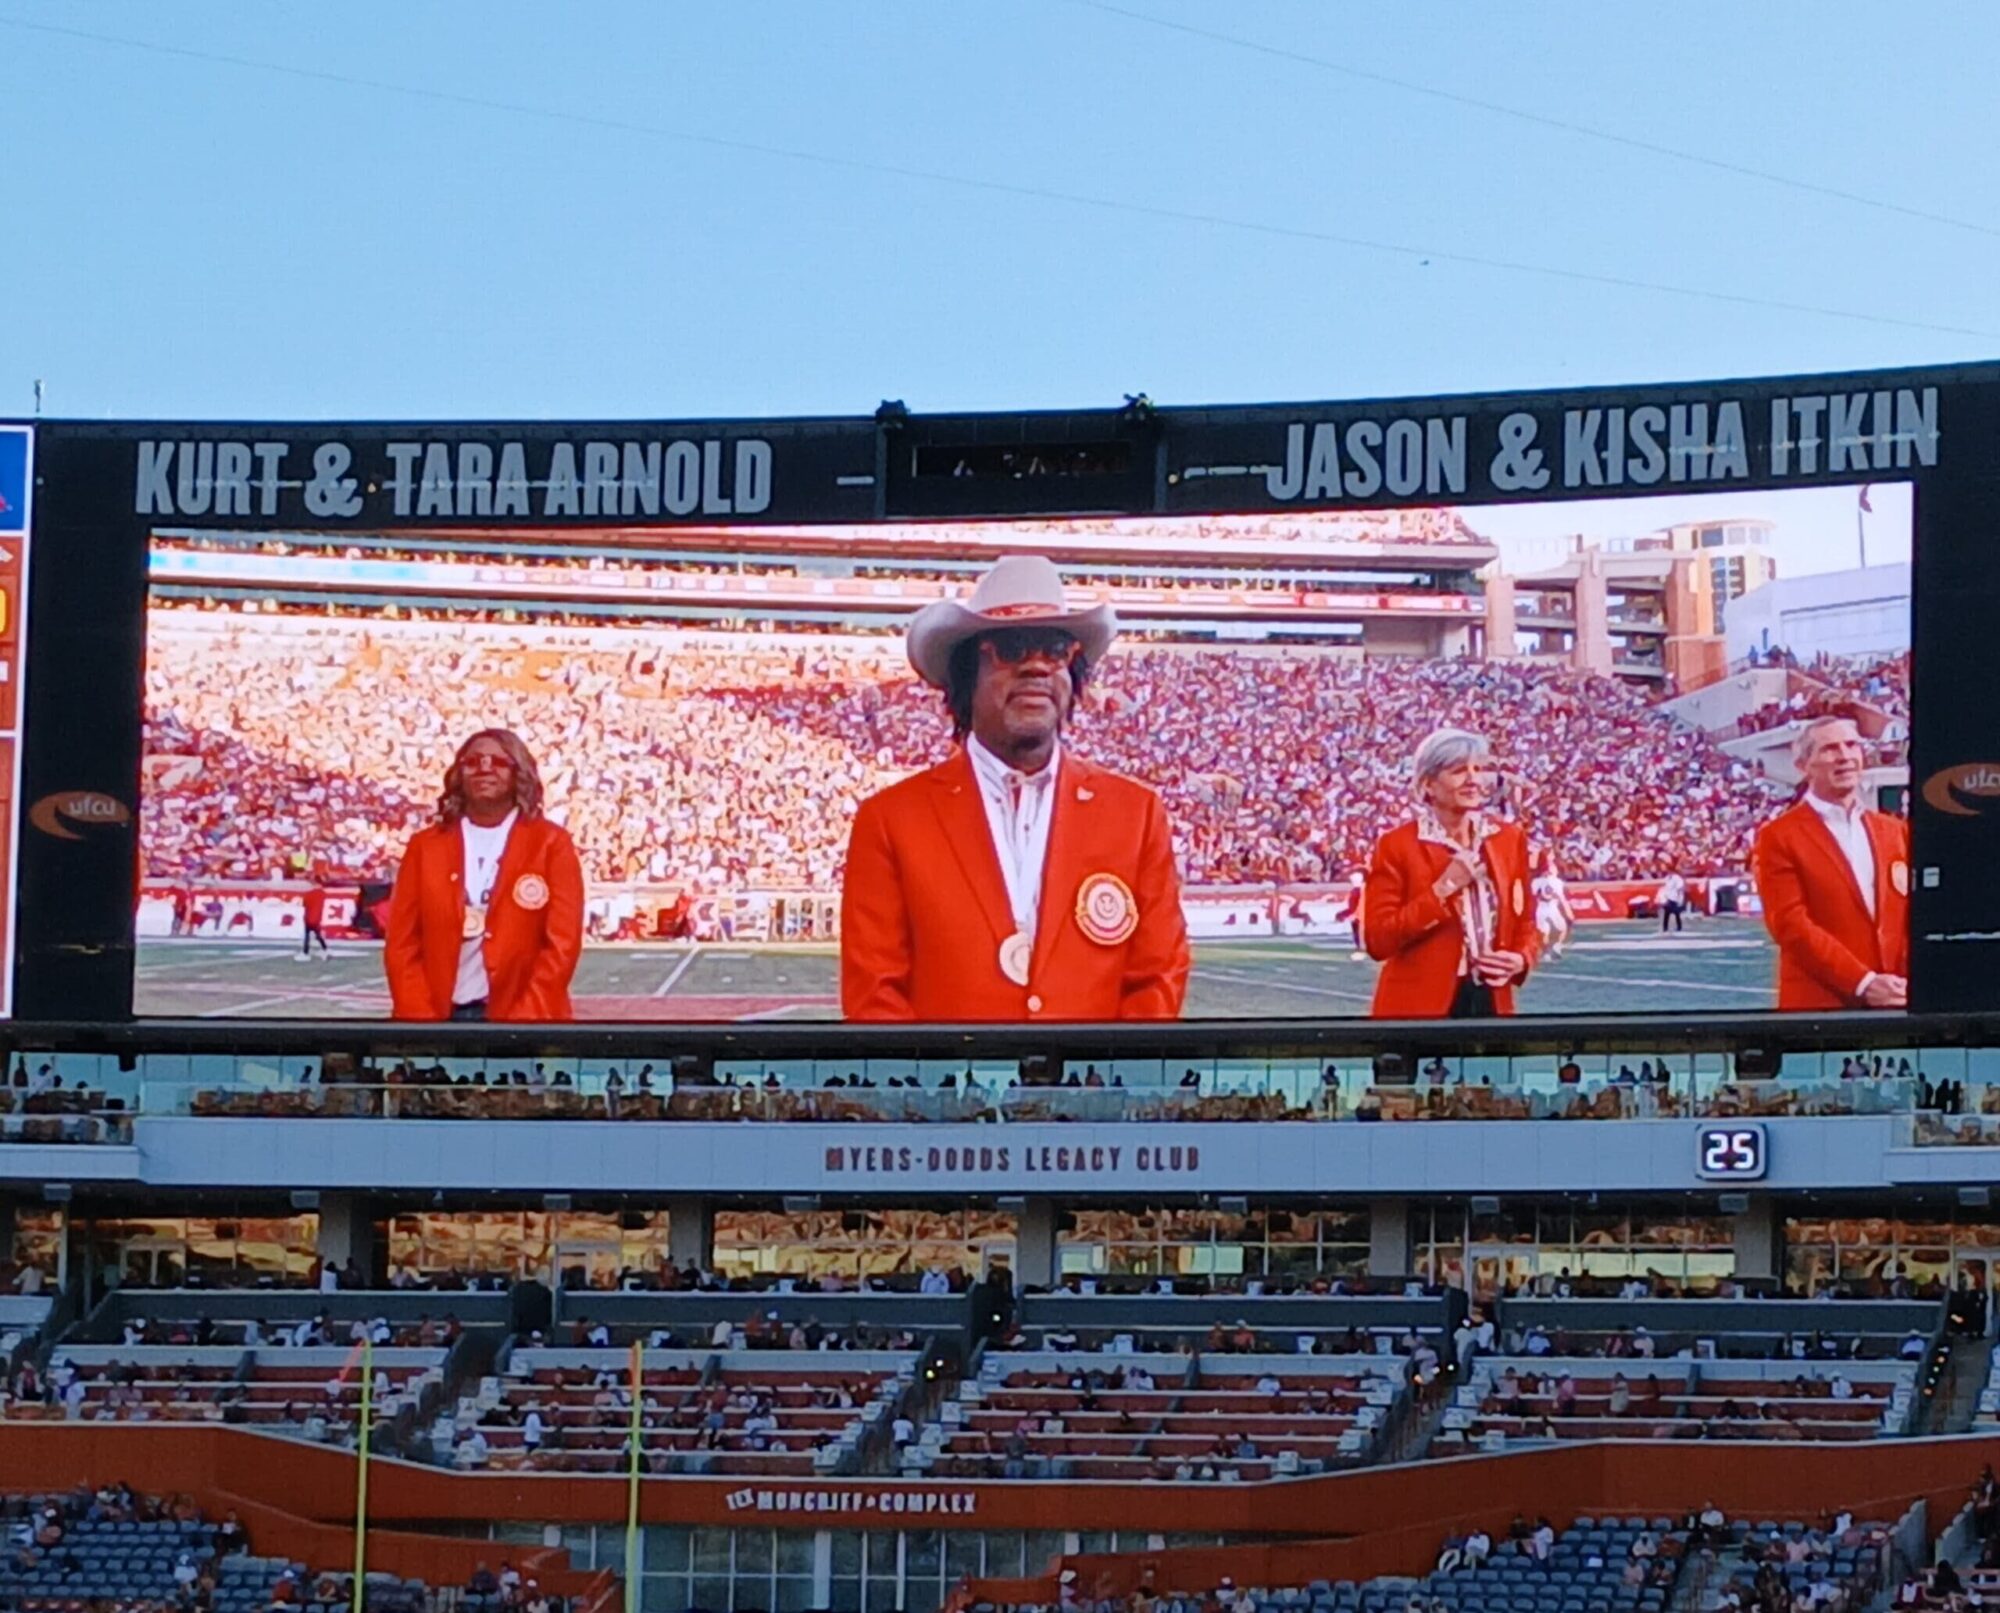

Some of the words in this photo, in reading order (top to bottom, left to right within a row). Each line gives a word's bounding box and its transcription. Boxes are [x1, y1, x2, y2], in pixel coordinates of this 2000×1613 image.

[1266, 416, 1467, 500] JASON
[1489, 412, 1551, 491] &
[1563, 401, 1749, 488] KISHA
[1770, 387, 1939, 476] ITKIN
[135, 440, 289, 515] KURT
[303, 441, 363, 517] &
[385, 442, 530, 515] TARA
[543, 440, 772, 515] ARNOLD
[1963, 768, 2000, 790] ufc
[1025, 1146, 1121, 1172] LEGACY
[1136, 1146, 1200, 1173] CLUB
[1706, 1132, 1755, 1170] 25
[879, 1492, 976, 1513] COMPLEX
